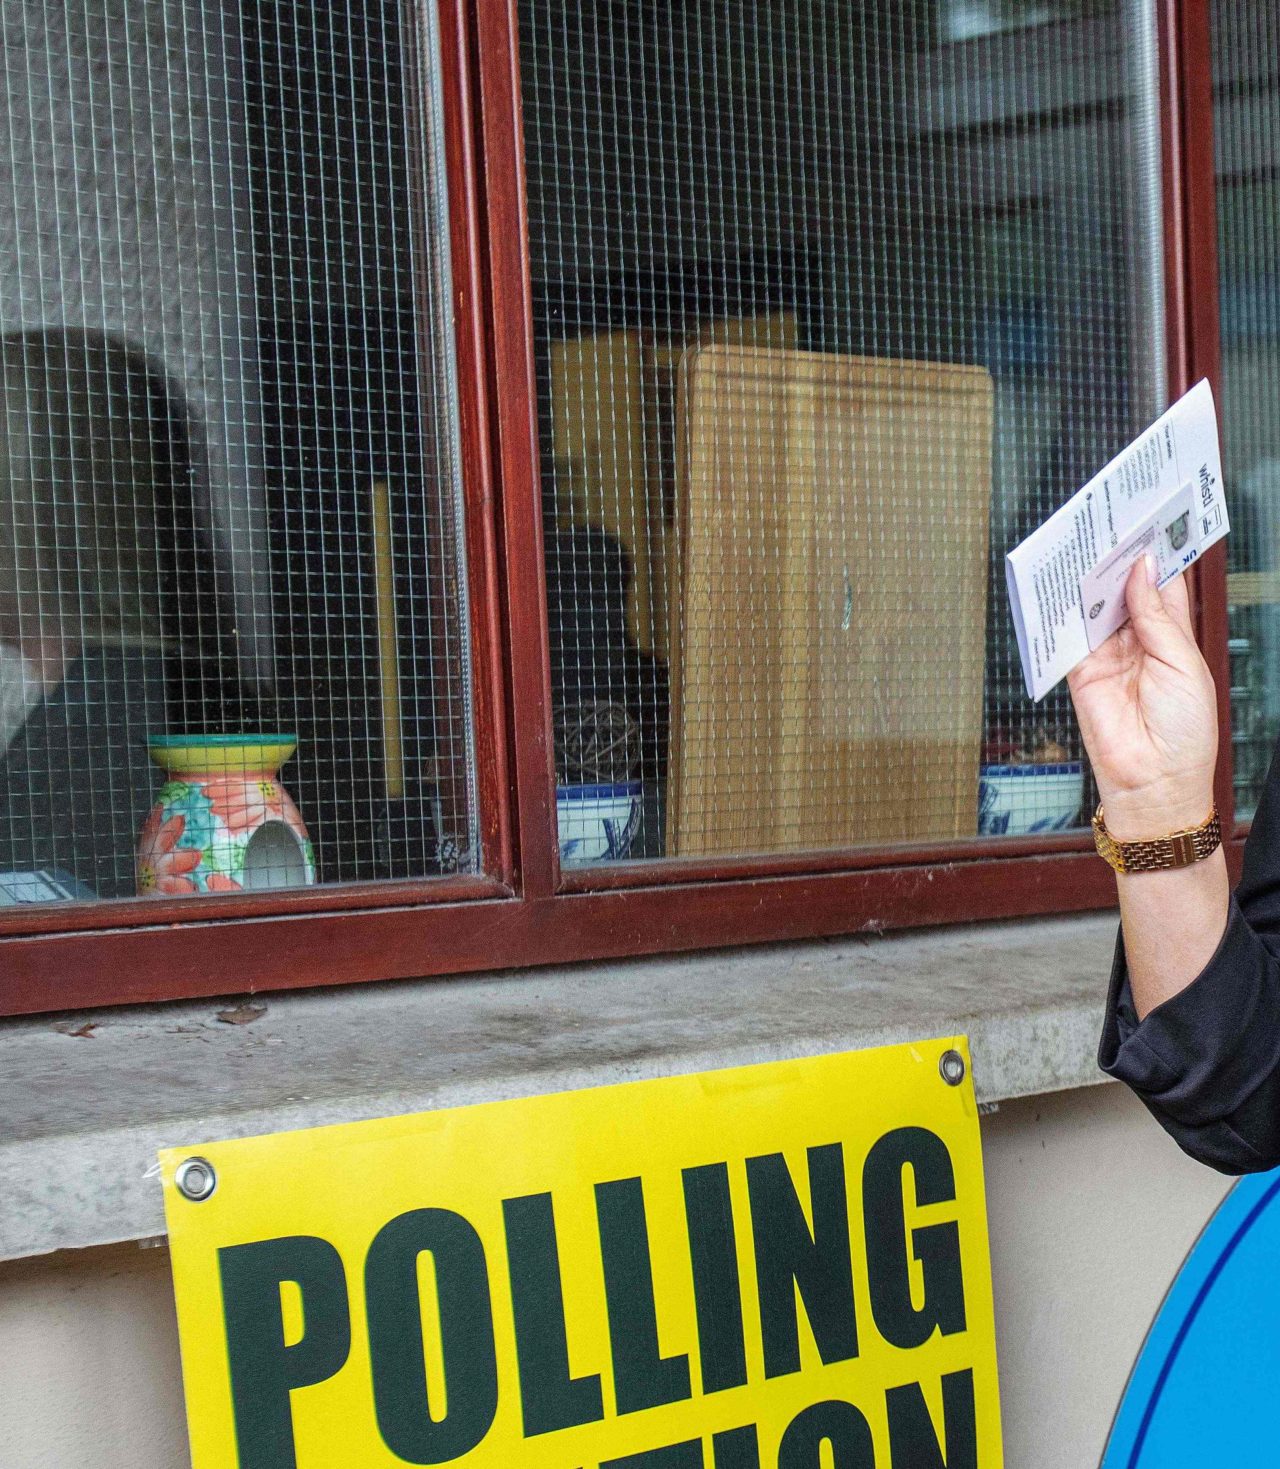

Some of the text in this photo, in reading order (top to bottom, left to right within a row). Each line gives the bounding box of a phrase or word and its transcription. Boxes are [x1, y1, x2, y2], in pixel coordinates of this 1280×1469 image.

[1198, 463, 1216, 509] whistl
[1182, 549, 1197, 565] UK
[218, 1126, 968, 1469] POLLING
